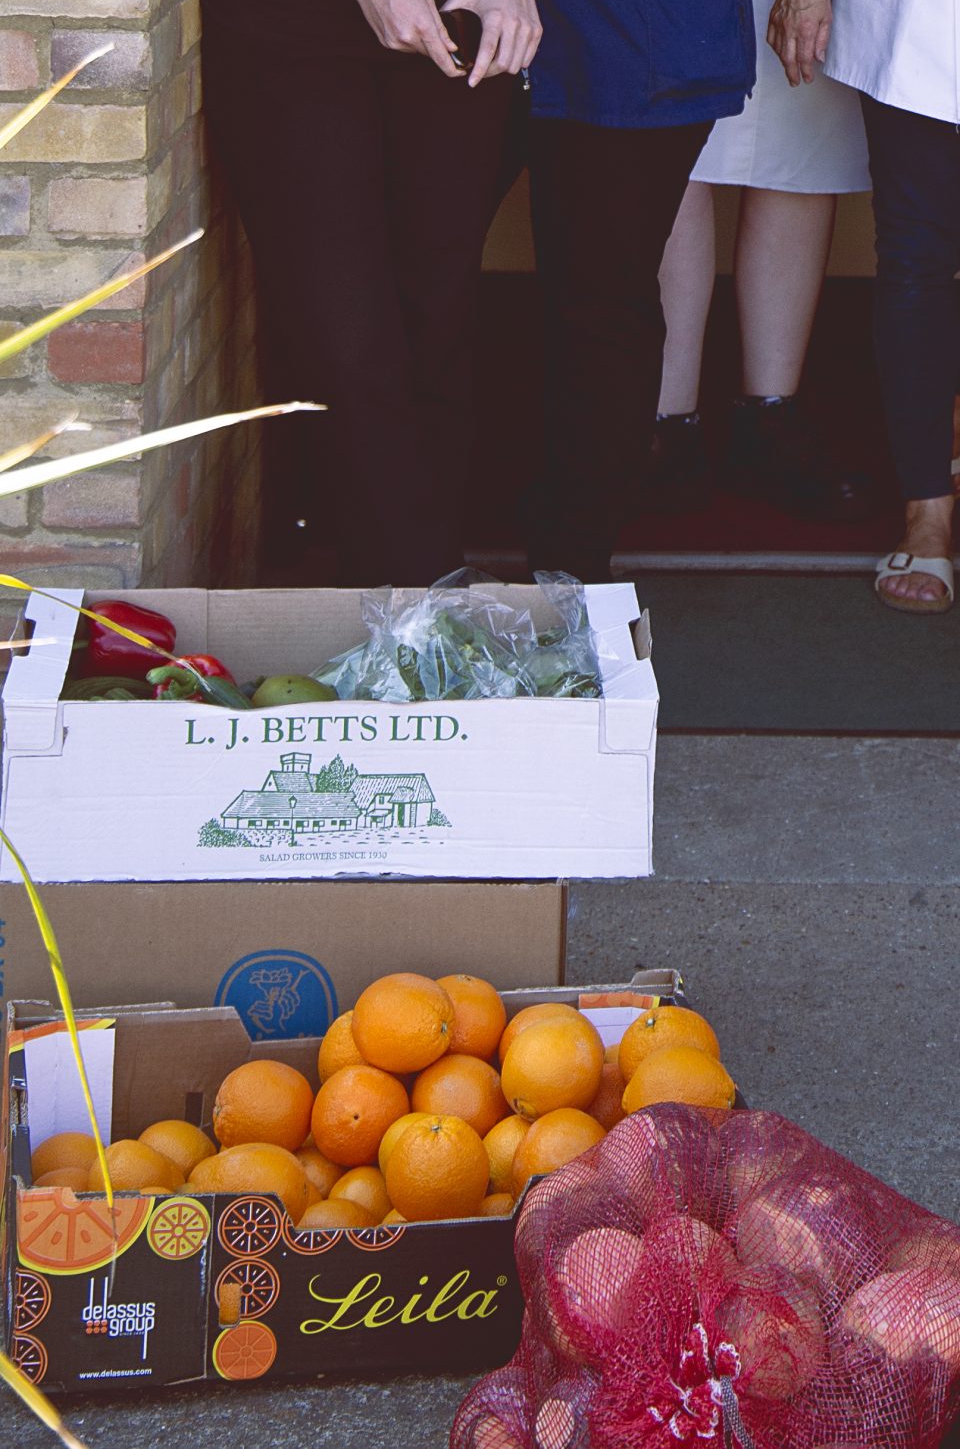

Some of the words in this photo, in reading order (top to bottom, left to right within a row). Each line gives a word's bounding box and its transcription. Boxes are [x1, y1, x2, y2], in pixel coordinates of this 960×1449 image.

[184, 719, 215, 746] L.
[226, 719, 250, 750] J.
[261, 715, 379, 744] BETTS
[389, 714, 469, 742] LTD.
[259, 853, 291, 862] SALAD
[291, 852, 337, 862] GROWERS
[339, 851, 367, 860] SINCE
[368, 851, 388, 860] 1930
[82, 1276, 156, 1320] delassus
[109, 1316, 155, 1360] group
[79, 1367, 153, 1379] www.delassus.com
